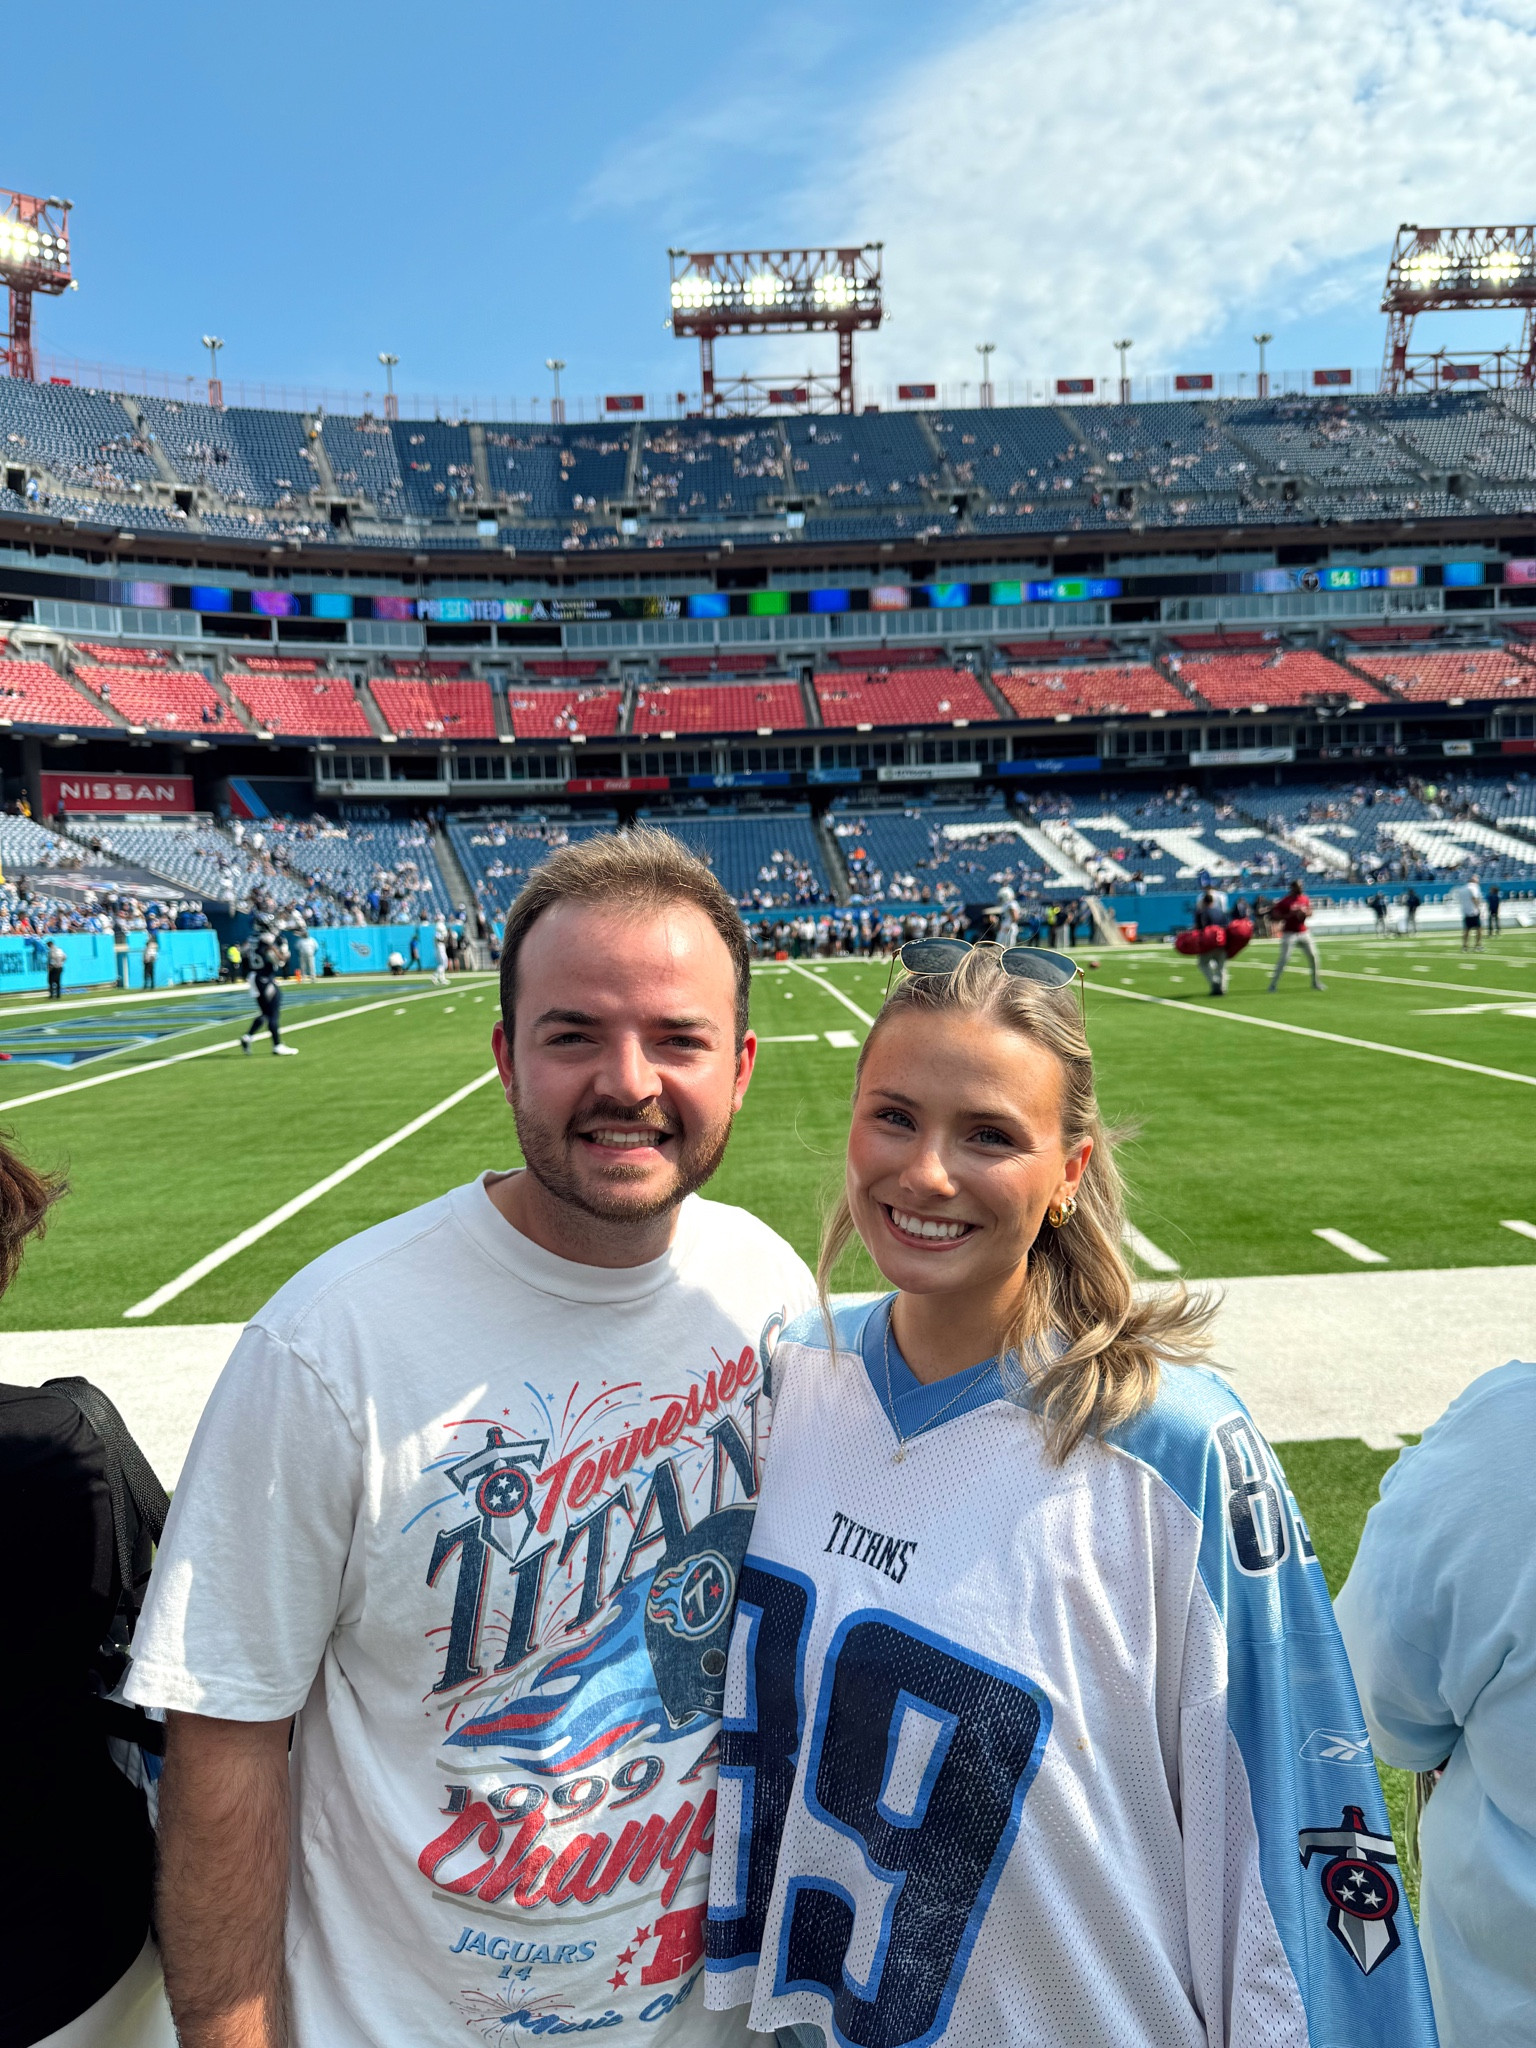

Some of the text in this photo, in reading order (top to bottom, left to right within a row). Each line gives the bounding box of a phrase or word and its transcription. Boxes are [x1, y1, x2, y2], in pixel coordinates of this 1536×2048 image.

[60, 782, 175, 801] NISSAN
[535, 1345, 759, 1534] Tennessee
[1212, 1409, 1319, 1578] 8
[823, 1510, 918, 1585] TITANS
[438, 1755, 665, 1826] 1999
[449, 1926, 597, 1965] JAGUARS
[498, 1964, 533, 1981] 14
[500, 2009, 624, 2035] Music
